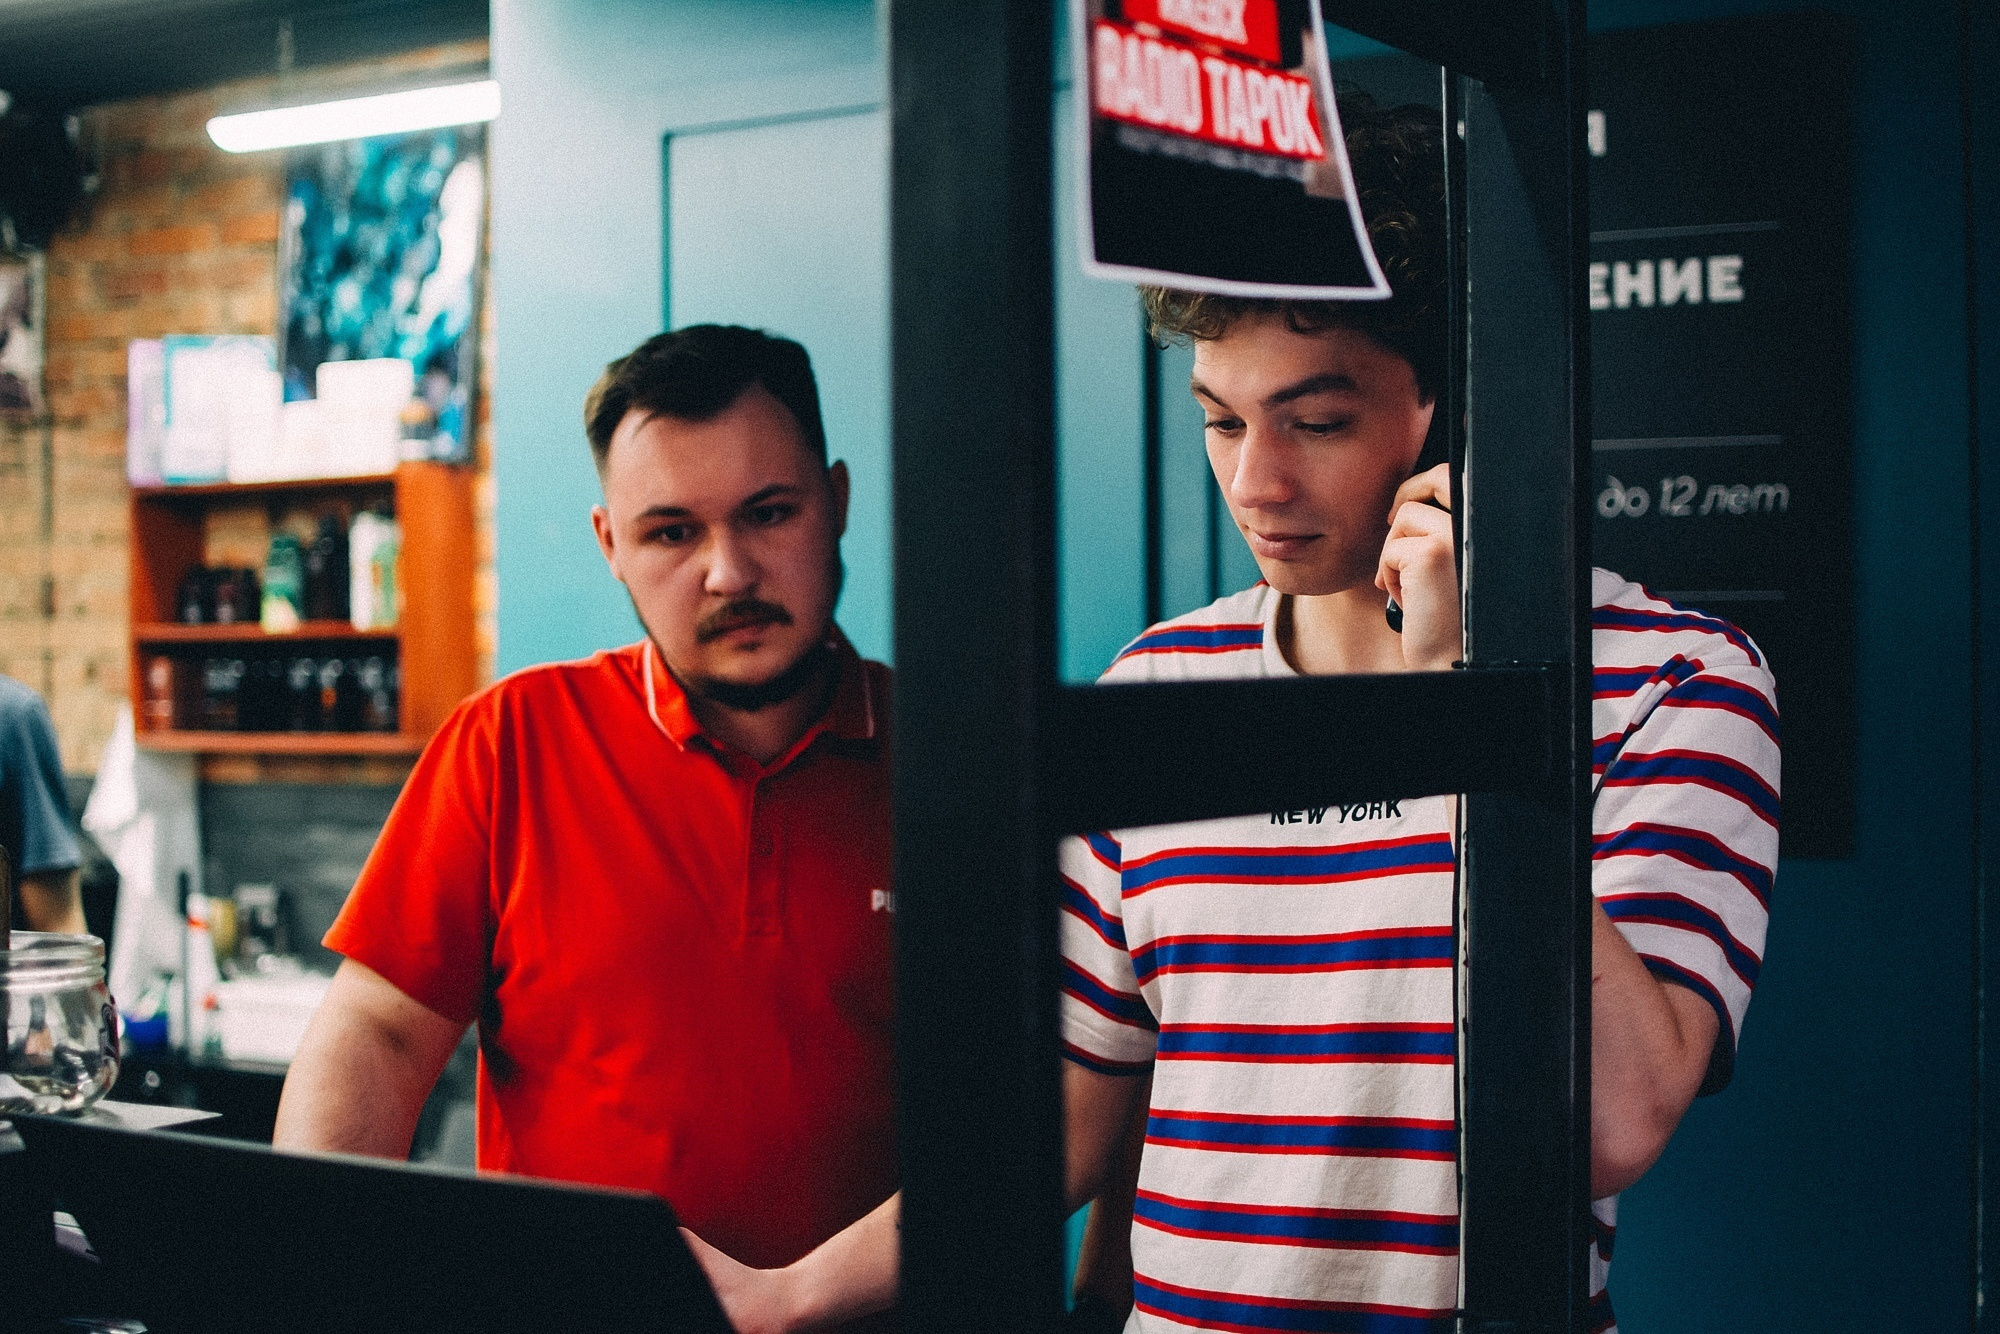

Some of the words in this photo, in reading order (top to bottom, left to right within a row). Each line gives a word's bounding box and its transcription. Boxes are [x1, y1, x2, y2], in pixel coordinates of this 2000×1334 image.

[1096, 24, 1203, 133] RADIO
[1203, 56, 1326, 157] TAPOK
[1598, 475, 1650, 518] до
[1660, 475, 1698, 517] 12
[1701, 482, 1790, 517] лет
[1270, 806, 1328, 826] NEW
[1338, 800, 1401, 824] YORK
